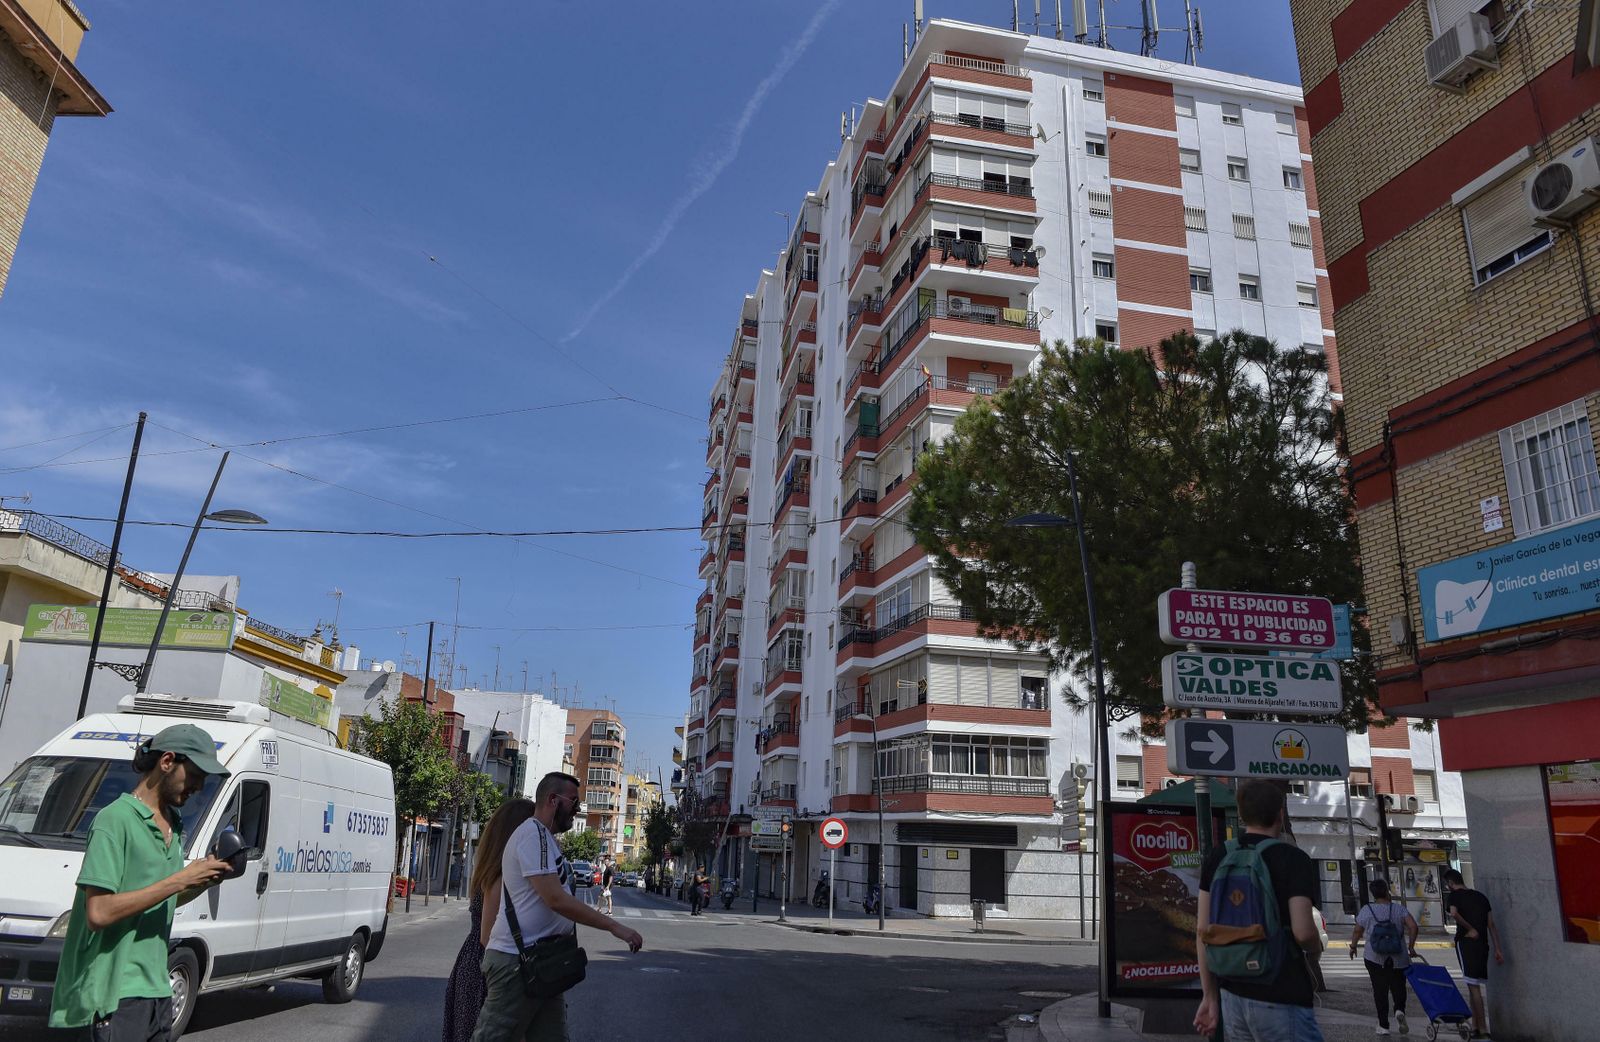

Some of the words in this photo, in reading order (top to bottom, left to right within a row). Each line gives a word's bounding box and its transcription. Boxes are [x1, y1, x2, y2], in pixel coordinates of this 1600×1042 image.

[1516, 544, 1546, 560] García
[1549, 541, 1561, 551] de
[1562, 538, 1572, 547] la
[1496, 575, 1537, 593] Clínica
[1540, 560, 1580, 582] dental
[1191, 594, 1225, 609] ESTE
[1229, 597, 1288, 613] ESPACIO
[1292, 600, 1310, 614] ES
[1175, 610, 1216, 626] PARA
[1219, 613, 1239, 627] TU
[1244, 615, 1327, 632] PUBLICIDAD
[1179, 625, 1221, 639] 902
[1229, 629, 1257, 641] 10
[1264, 631, 1292, 643] 36
[1299, 633, 1326, 645] 69
[1208, 657, 1335, 682] OPTICA
[1178, 676, 1279, 697] VALDES
[79, 731, 119, 741] 954
[1248, 761, 1342, 777] MERCADONA
[347, 811, 389, 836] 673575837
[1136, 831, 1188, 850] nocilla
[1172, 853, 1189, 867] SIN
[10, 989, 30, 999] SP
